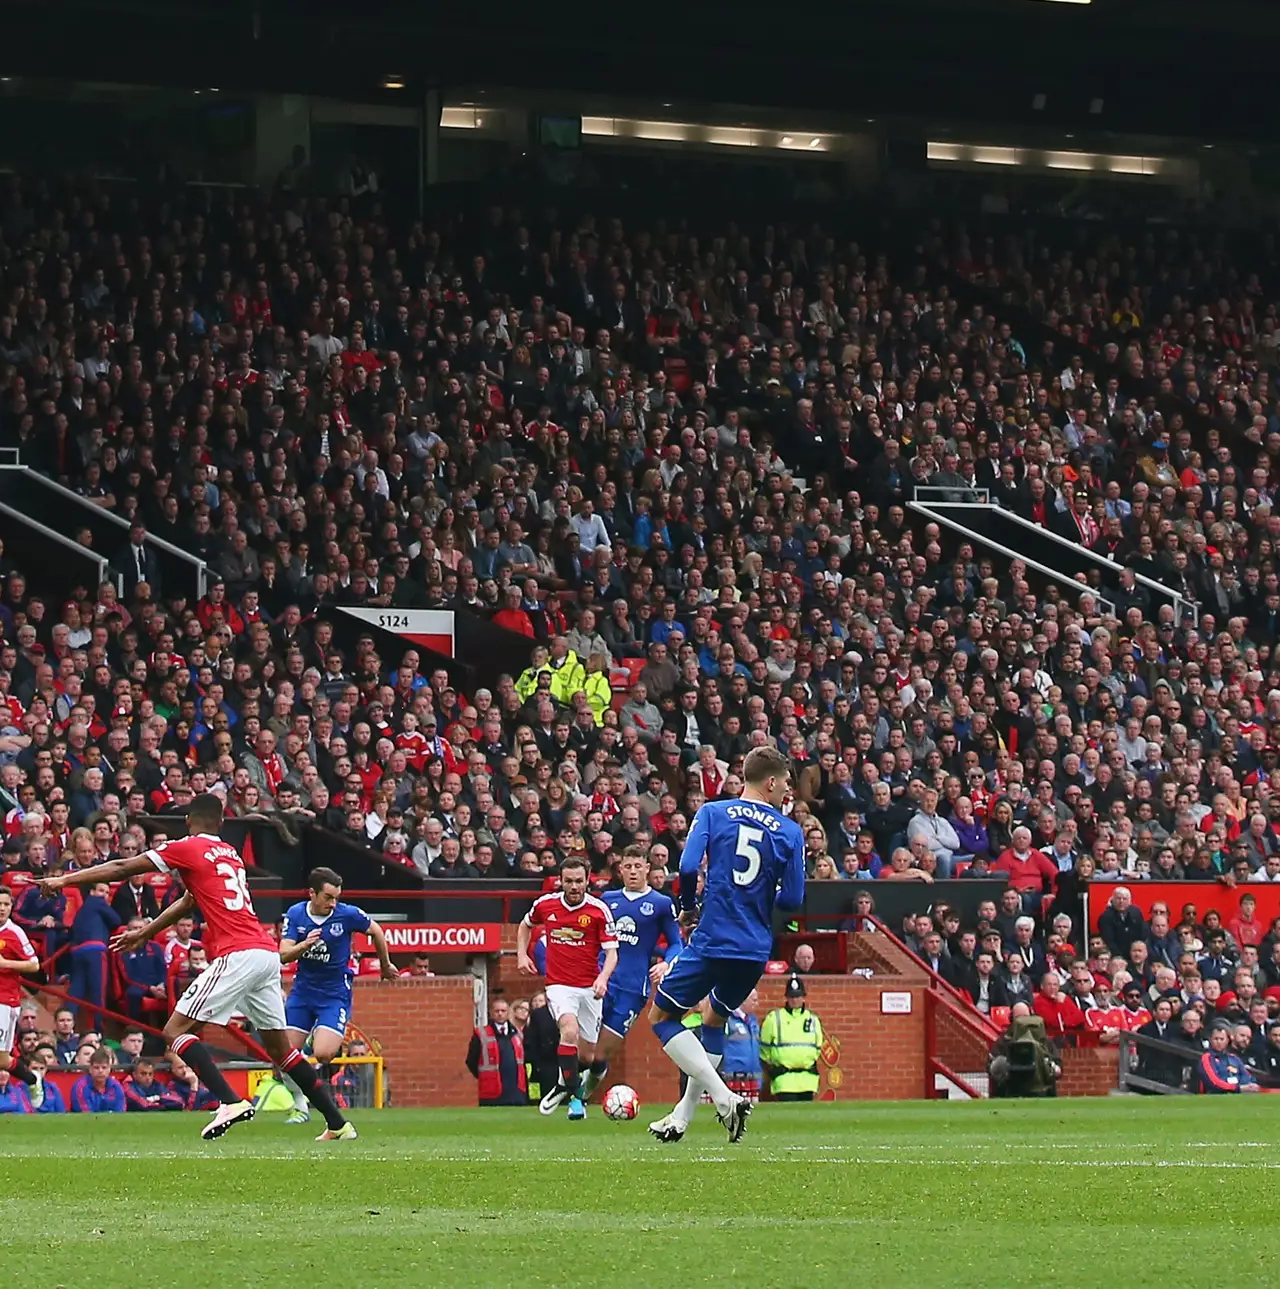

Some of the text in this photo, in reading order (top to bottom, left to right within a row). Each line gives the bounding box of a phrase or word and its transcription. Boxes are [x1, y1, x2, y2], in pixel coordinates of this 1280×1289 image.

[378, 615, 409, 628] S124
[726, 804, 781, 832] STONES
[732, 823, 764, 886] 5
[368, 927, 485, 946] ANUTD.COM
